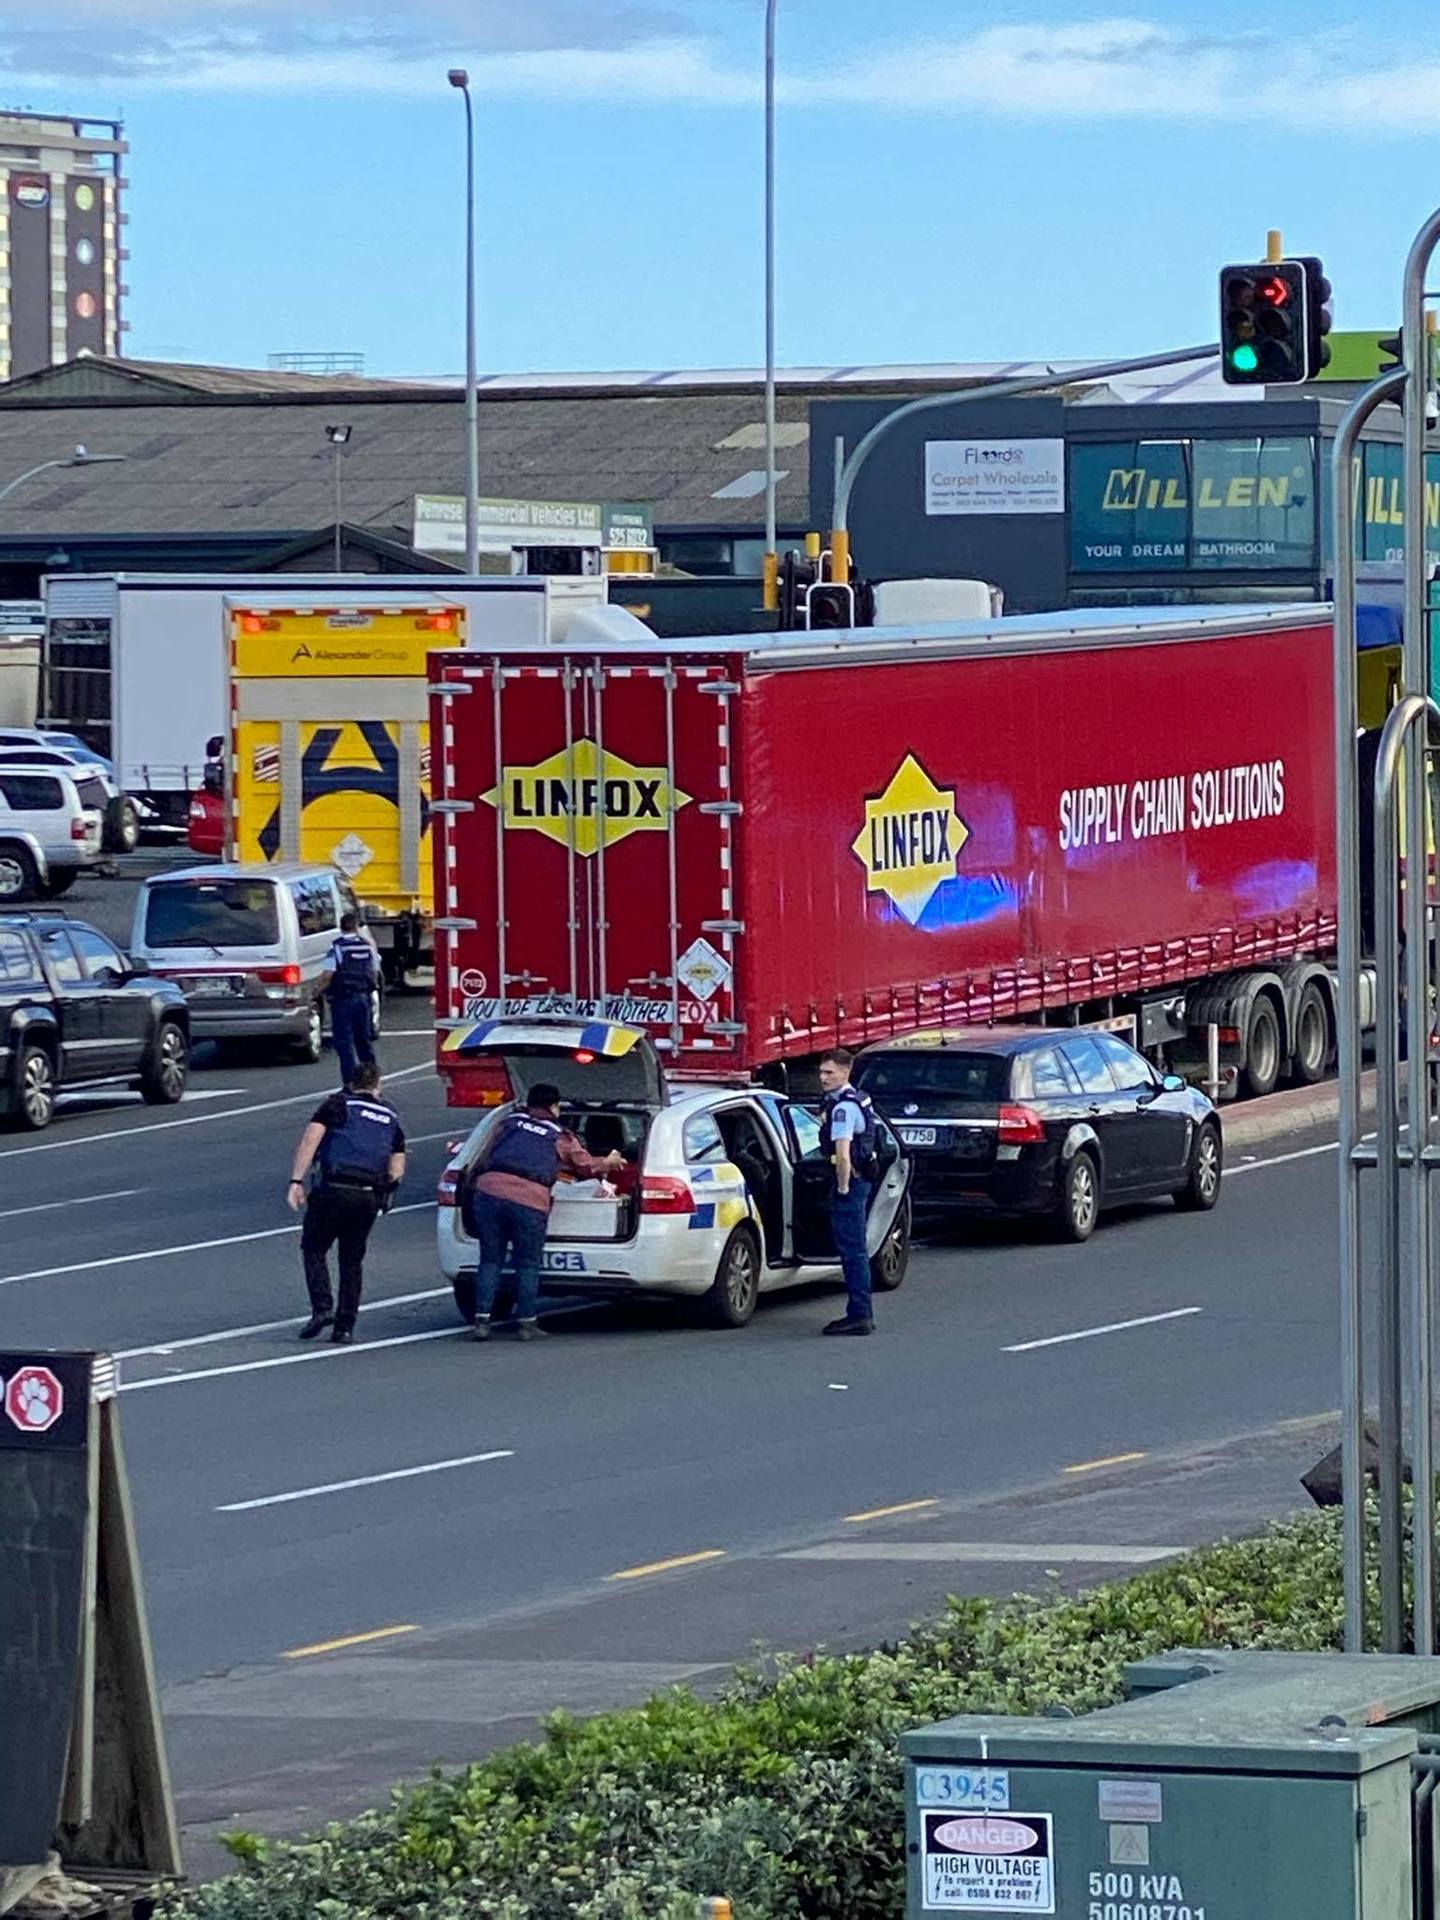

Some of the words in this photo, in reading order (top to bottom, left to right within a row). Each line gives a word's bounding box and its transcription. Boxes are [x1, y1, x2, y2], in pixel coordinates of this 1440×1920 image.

[931, 472, 980, 487] Carpet
[983, 470, 1058, 485] Wholesale
[1102, 469, 1290, 510] MILLEN
[531, 504, 576, 526] Vehicles
[1084, 545, 1122, 558] YOUR
[1133, 543, 1185, 557] DREAM
[1199, 542, 1275, 555] BATHROOM
[513, 778, 662, 818] LINFOX
[1059, 783, 1128, 850] SUPPLY
[1130, 775, 1185, 841] CHAIN
[1190, 759, 1284, 831] SOLUTIONS
[870, 808, 953, 872] LINFOX
[465, 1000, 498, 1019] YOU
[678, 1001, 718, 1023] FOX
[918, 1773, 1007, 1802] C3945
[943, 1826, 1028, 1846] DANGER
[934, 1856, 970, 1874] HIGH
[975, 1858, 1041, 1877] VOLTAGE
[957, 1876, 984, 1886] report
[997, 1877, 1033, 1887] problem
[1089, 1872, 1133, 1898] 500
[1140, 1875, 1184, 1901] kVA
